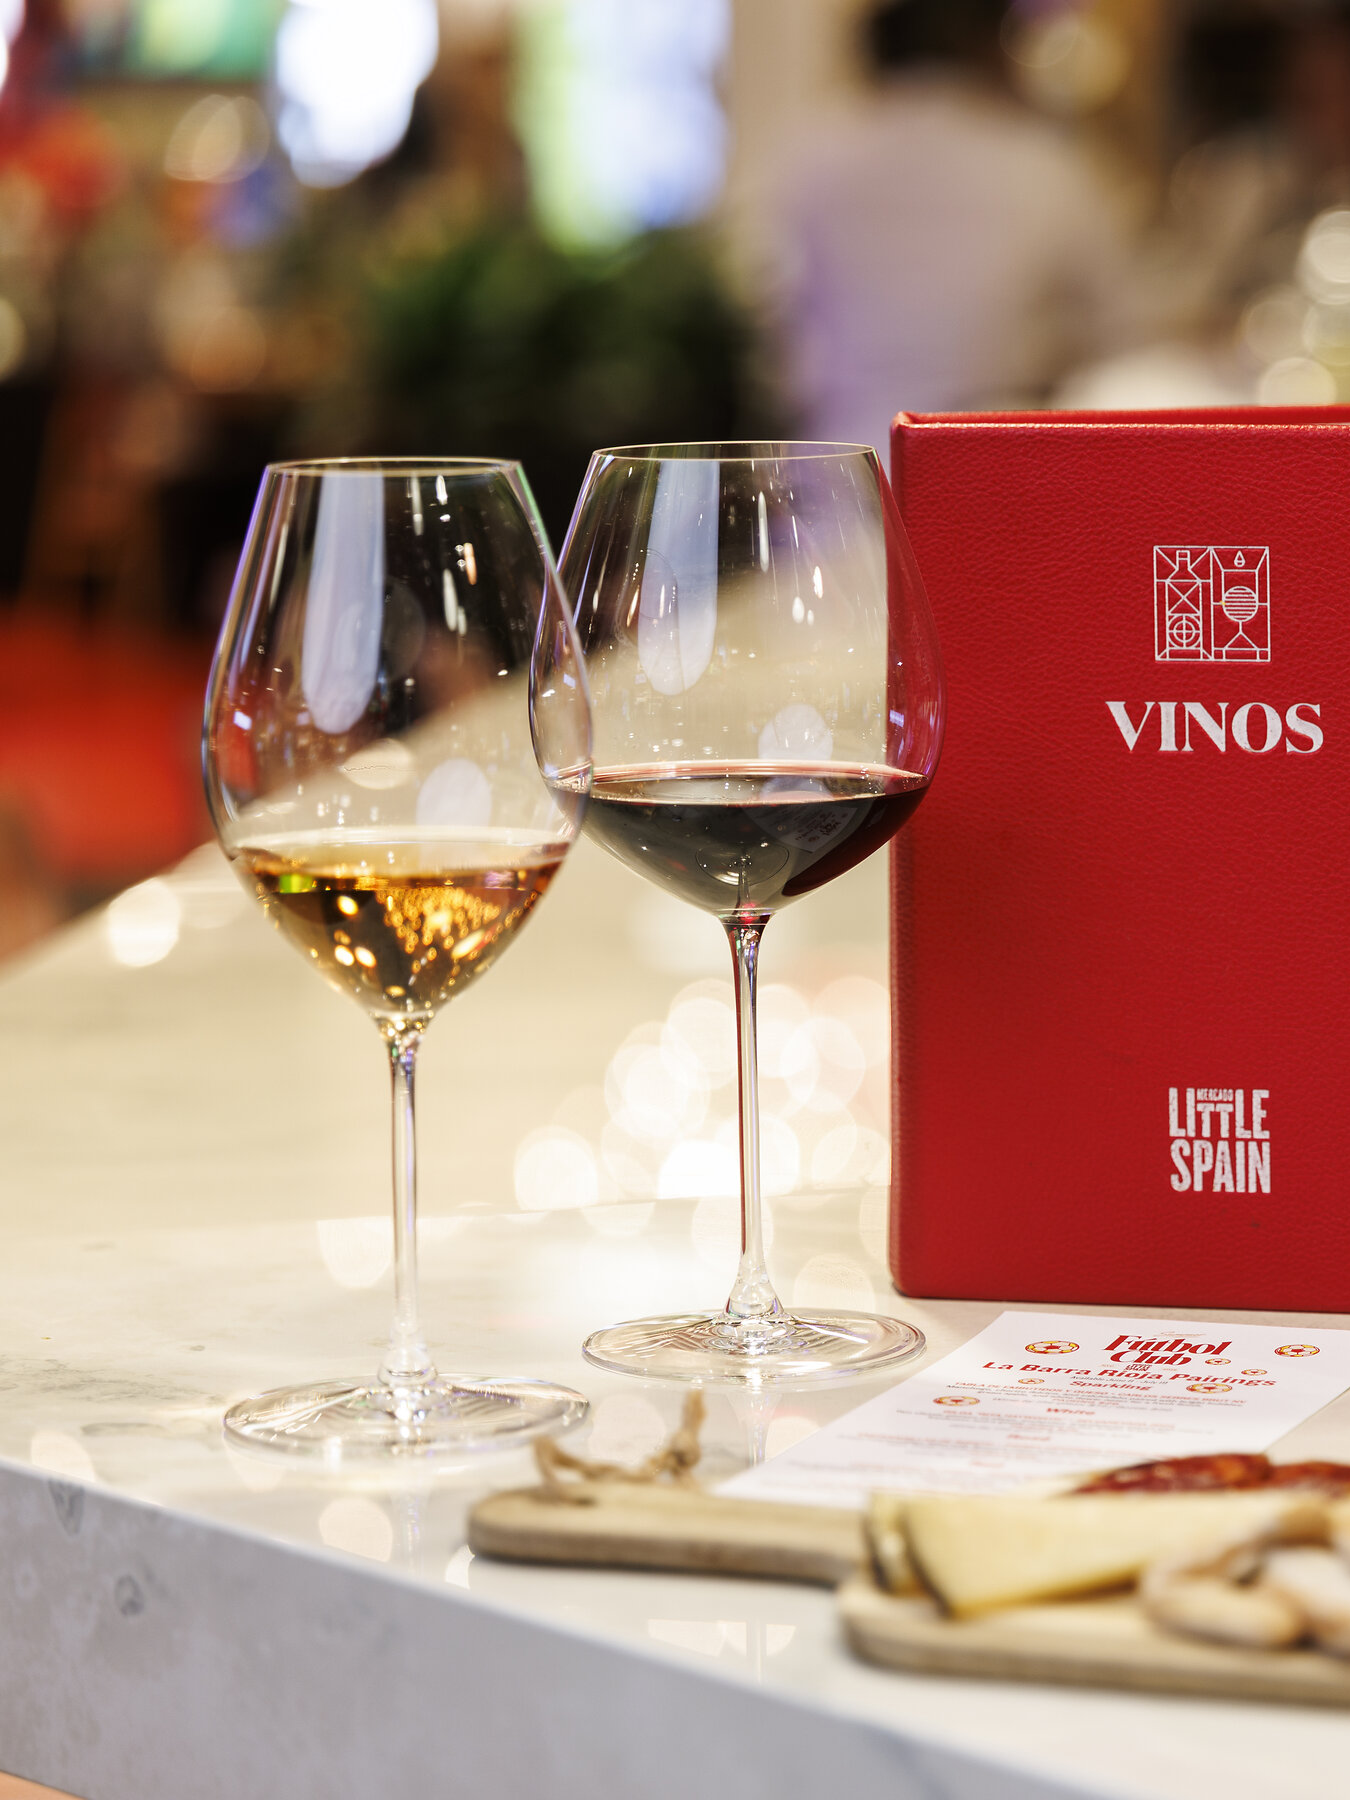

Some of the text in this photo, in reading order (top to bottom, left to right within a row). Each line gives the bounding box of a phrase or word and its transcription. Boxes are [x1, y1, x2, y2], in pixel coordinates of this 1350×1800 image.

[1105, 700, 1324, 754] VINOS
[1168, 1087, 1271, 1139] LITTLE
[1170, 1139, 1271, 1194] SPAIN
[1104, 1334, 1232, 1355] Fútbol
[1110, 1350, 1192, 1366] Club
[982, 1361, 1277, 1386] La Barra Rioja Pairings
[1069, 1381, 1153, 1391] Sparkling
